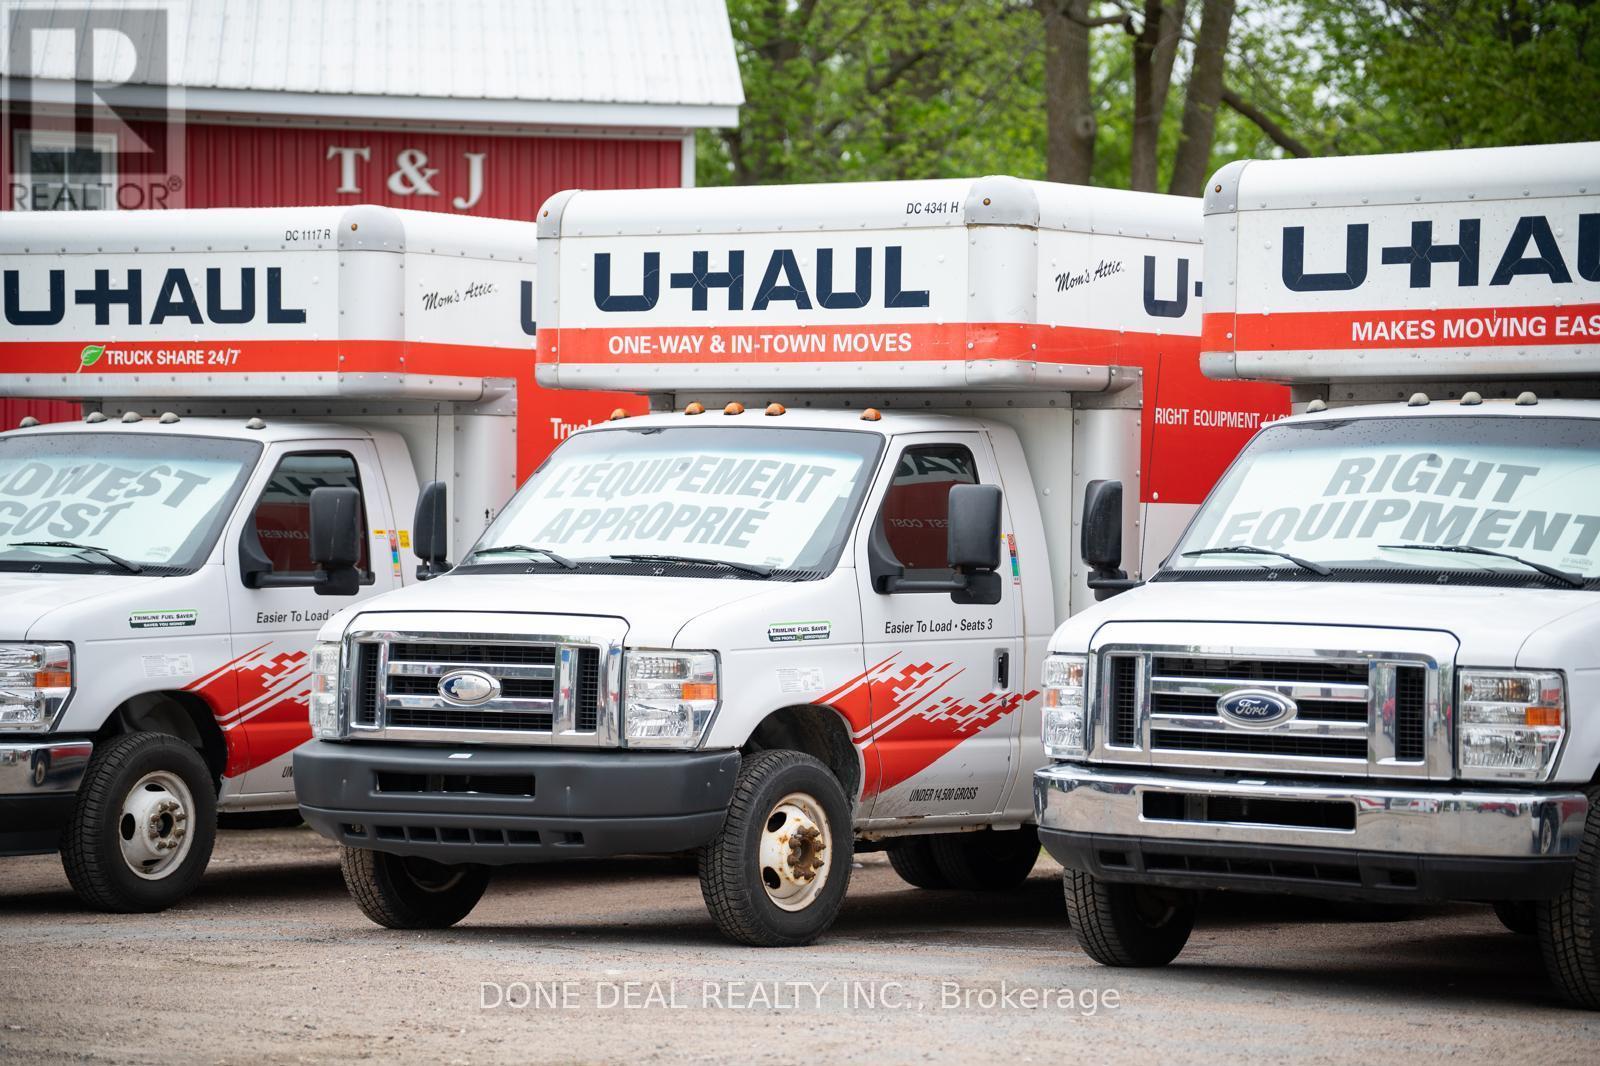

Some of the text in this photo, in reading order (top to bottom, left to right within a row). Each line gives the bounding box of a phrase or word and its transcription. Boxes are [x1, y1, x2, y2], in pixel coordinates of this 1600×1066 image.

[326, 145, 487, 209] T & J
[906, 201, 959, 214] DC 4341 H
[285, 228, 331, 241] DC 1117 R
[1282, 212, 1600, 293] U-HA
[594, 245, 931, 313] U-HAUL
[1055, 259, 1122, 293] Mom's Attic
[3, 266, 307, 326] U-HAUL
[422, 281, 494, 312] Mom's Attic
[1351, 319, 1436, 342] MAKES
[1443, 316, 1547, 339] MOVING
[105, 348, 241, 366] TRUCK SHARE 24/7
[608, 332, 912, 355] ONE-WAY & IN-TOWN MOVES
[1155, 407, 1190, 426] RIGHT
[1193, 409, 1260, 429] EQUIPMENT
[543, 450, 836, 503] L'ÉQUIPEMENT
[1322, 452, 1541, 503] RIGHT
[531, 500, 770, 549] APPROPRIÉ
[1212, 499, 1600, 556] EQUIPMENT
[256, 609, 330, 624] Easier To Load
[884, 618, 993, 634] Easier To Load Seats 3
[1235, 698, 1269, 716] Ford
[909, 788, 934, 802] UNDER
[953, 786, 979, 800] GROSS
